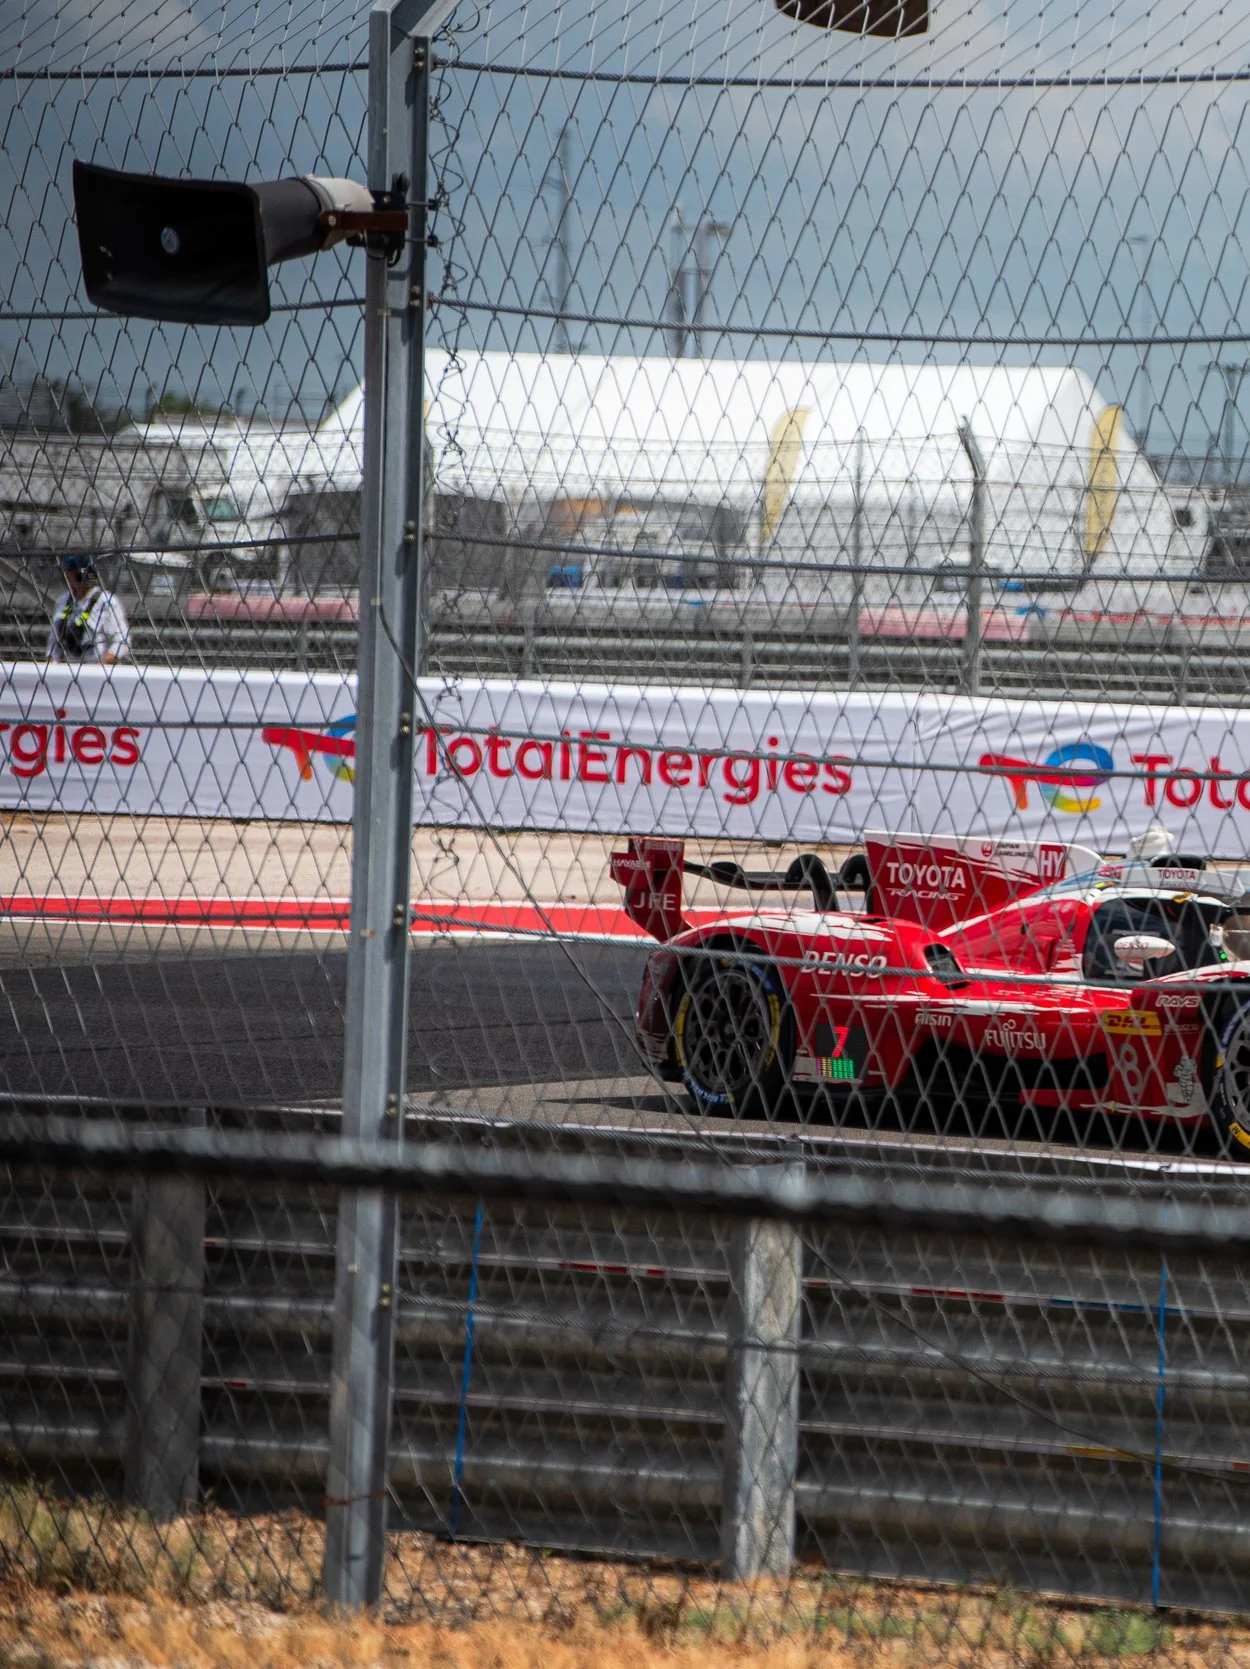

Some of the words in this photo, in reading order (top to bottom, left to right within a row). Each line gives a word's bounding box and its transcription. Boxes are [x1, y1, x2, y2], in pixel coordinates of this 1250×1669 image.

[0, 708, 140, 778] gies
[415, 726, 853, 806] TotalEnergies
[886, 862, 967, 889] TOYOTA
[1157, 869, 1197, 881] TOYOTA
[633, 891, 677, 911] JFE
[885, 887, 966, 901] RACING
[801, 949, 888, 979] DENSO
[1155, 995, 1201, 1008] RAYS
[1107, 1014, 1151, 1030] DHL
[832, 1025, 849, 1059] 7
[984, 1028, 1047, 1050] FUJITSU
[1119, 1043, 1144, 1094] 8
